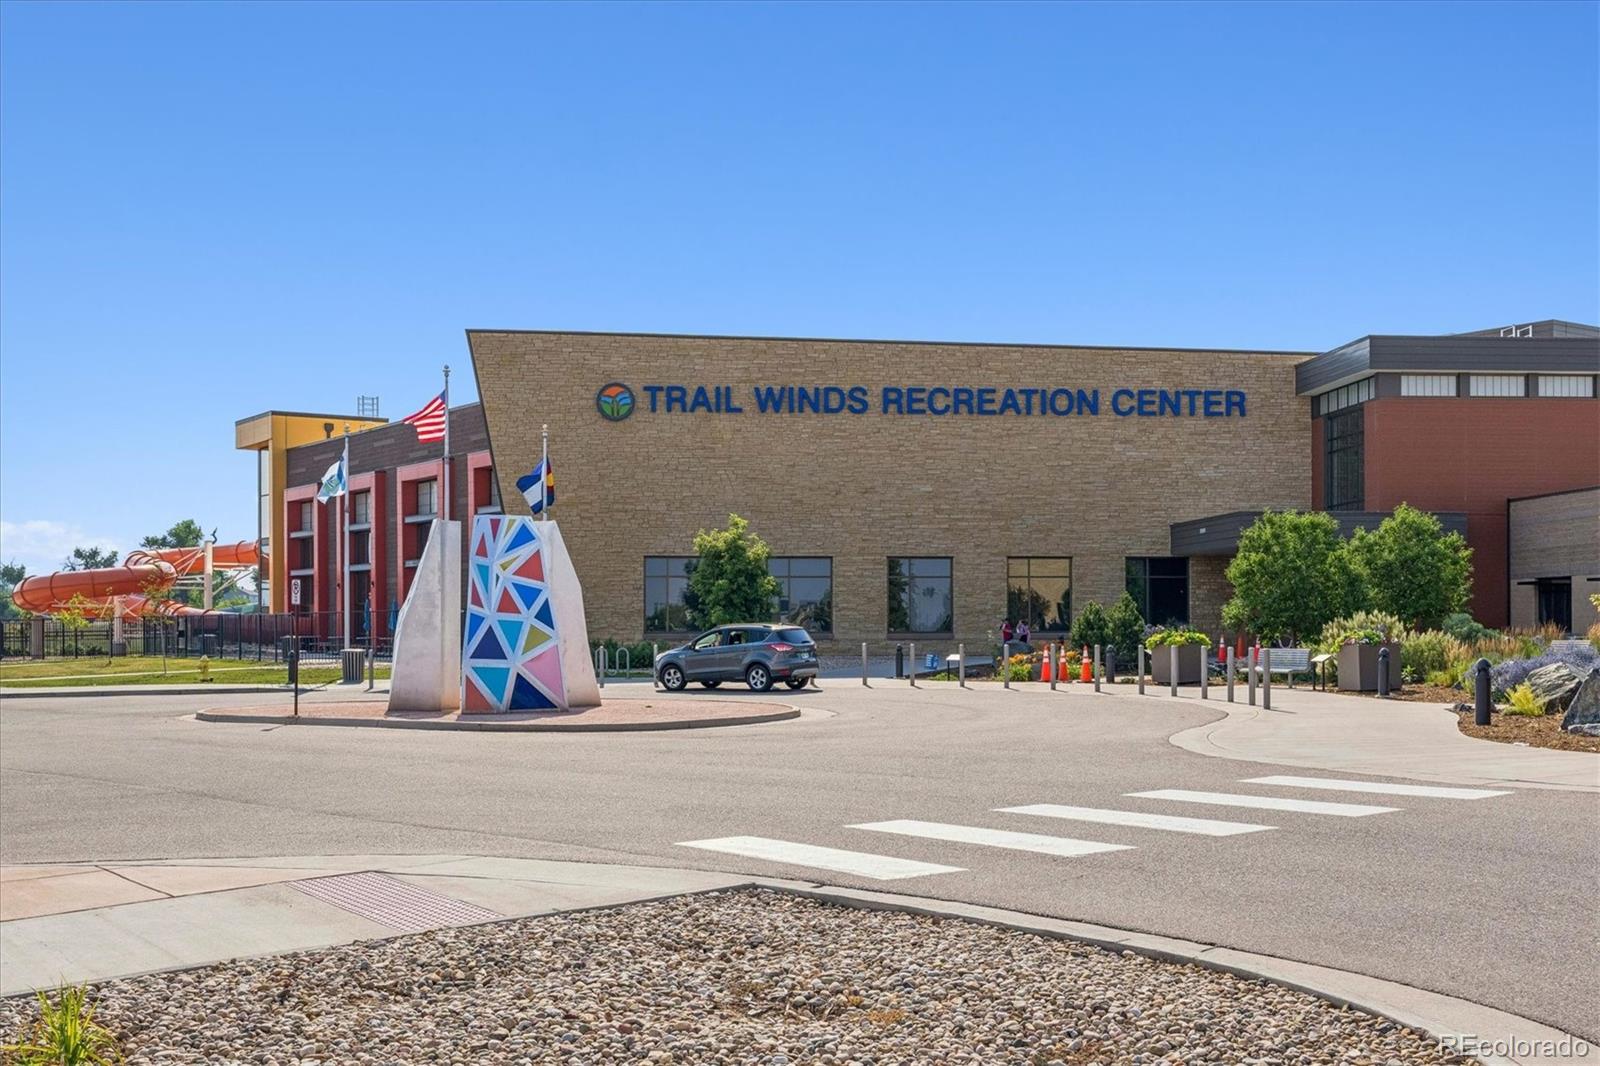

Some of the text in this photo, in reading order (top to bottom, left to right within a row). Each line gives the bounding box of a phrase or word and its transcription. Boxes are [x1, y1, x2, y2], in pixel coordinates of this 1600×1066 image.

[643, 386, 1246, 417] TRAIL WINDS RECREATION CENTER
